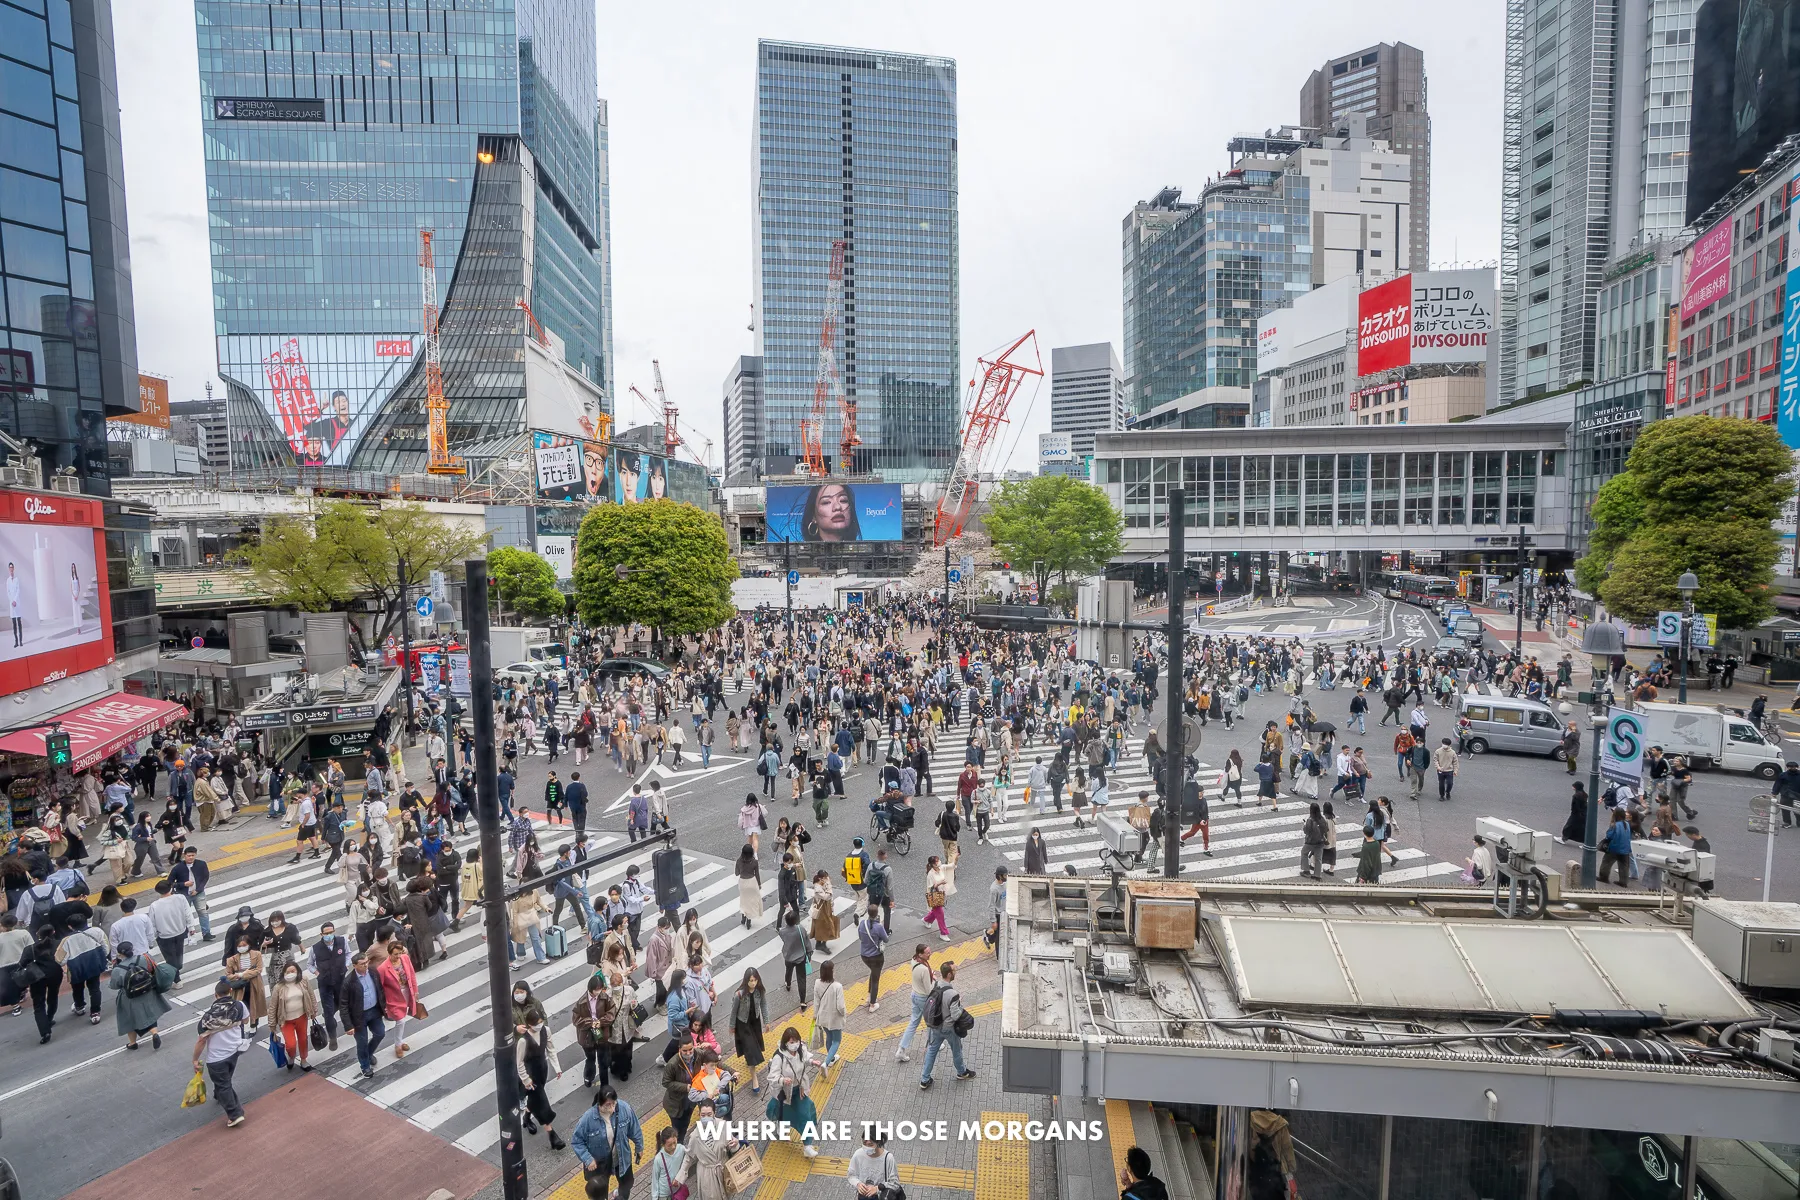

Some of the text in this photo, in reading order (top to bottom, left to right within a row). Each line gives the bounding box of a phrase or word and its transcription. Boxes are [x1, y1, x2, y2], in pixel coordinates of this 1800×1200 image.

[236, 101, 275, 109] SHIBUYA
[236, 109, 322, 119] SCRAMBLE SQUARE
[1702, 227, 1729, 253] 品川スキン
[1702, 242, 1727, 267] クリニック
[1414, 286, 1474, 302] ココロの
[1686, 273, 1727, 312] 品川美容外科
[1414, 303, 1491, 318] ボリューム、
[1360, 305, 1409, 336] カラオケ
[1413, 318, 1492, 332] あげていこう。
[1360, 323, 1410, 350] JOYSOUND
[378, 343, 411, 354] バイトル
[1594, 405, 1624, 417] SHIBUYA
[1580, 408, 1643, 429] MARK CITY
[24, 497, 56, 521] Glico
[865, 507, 887, 518] Beyond
[545, 545, 565, 555] Olive
[128, 566, 145, 575] COFFEE
[304, 711, 330, 719] しぶちか
[343, 732, 371, 741] しぶちか
[75, 750, 102, 771] SANZENRI
